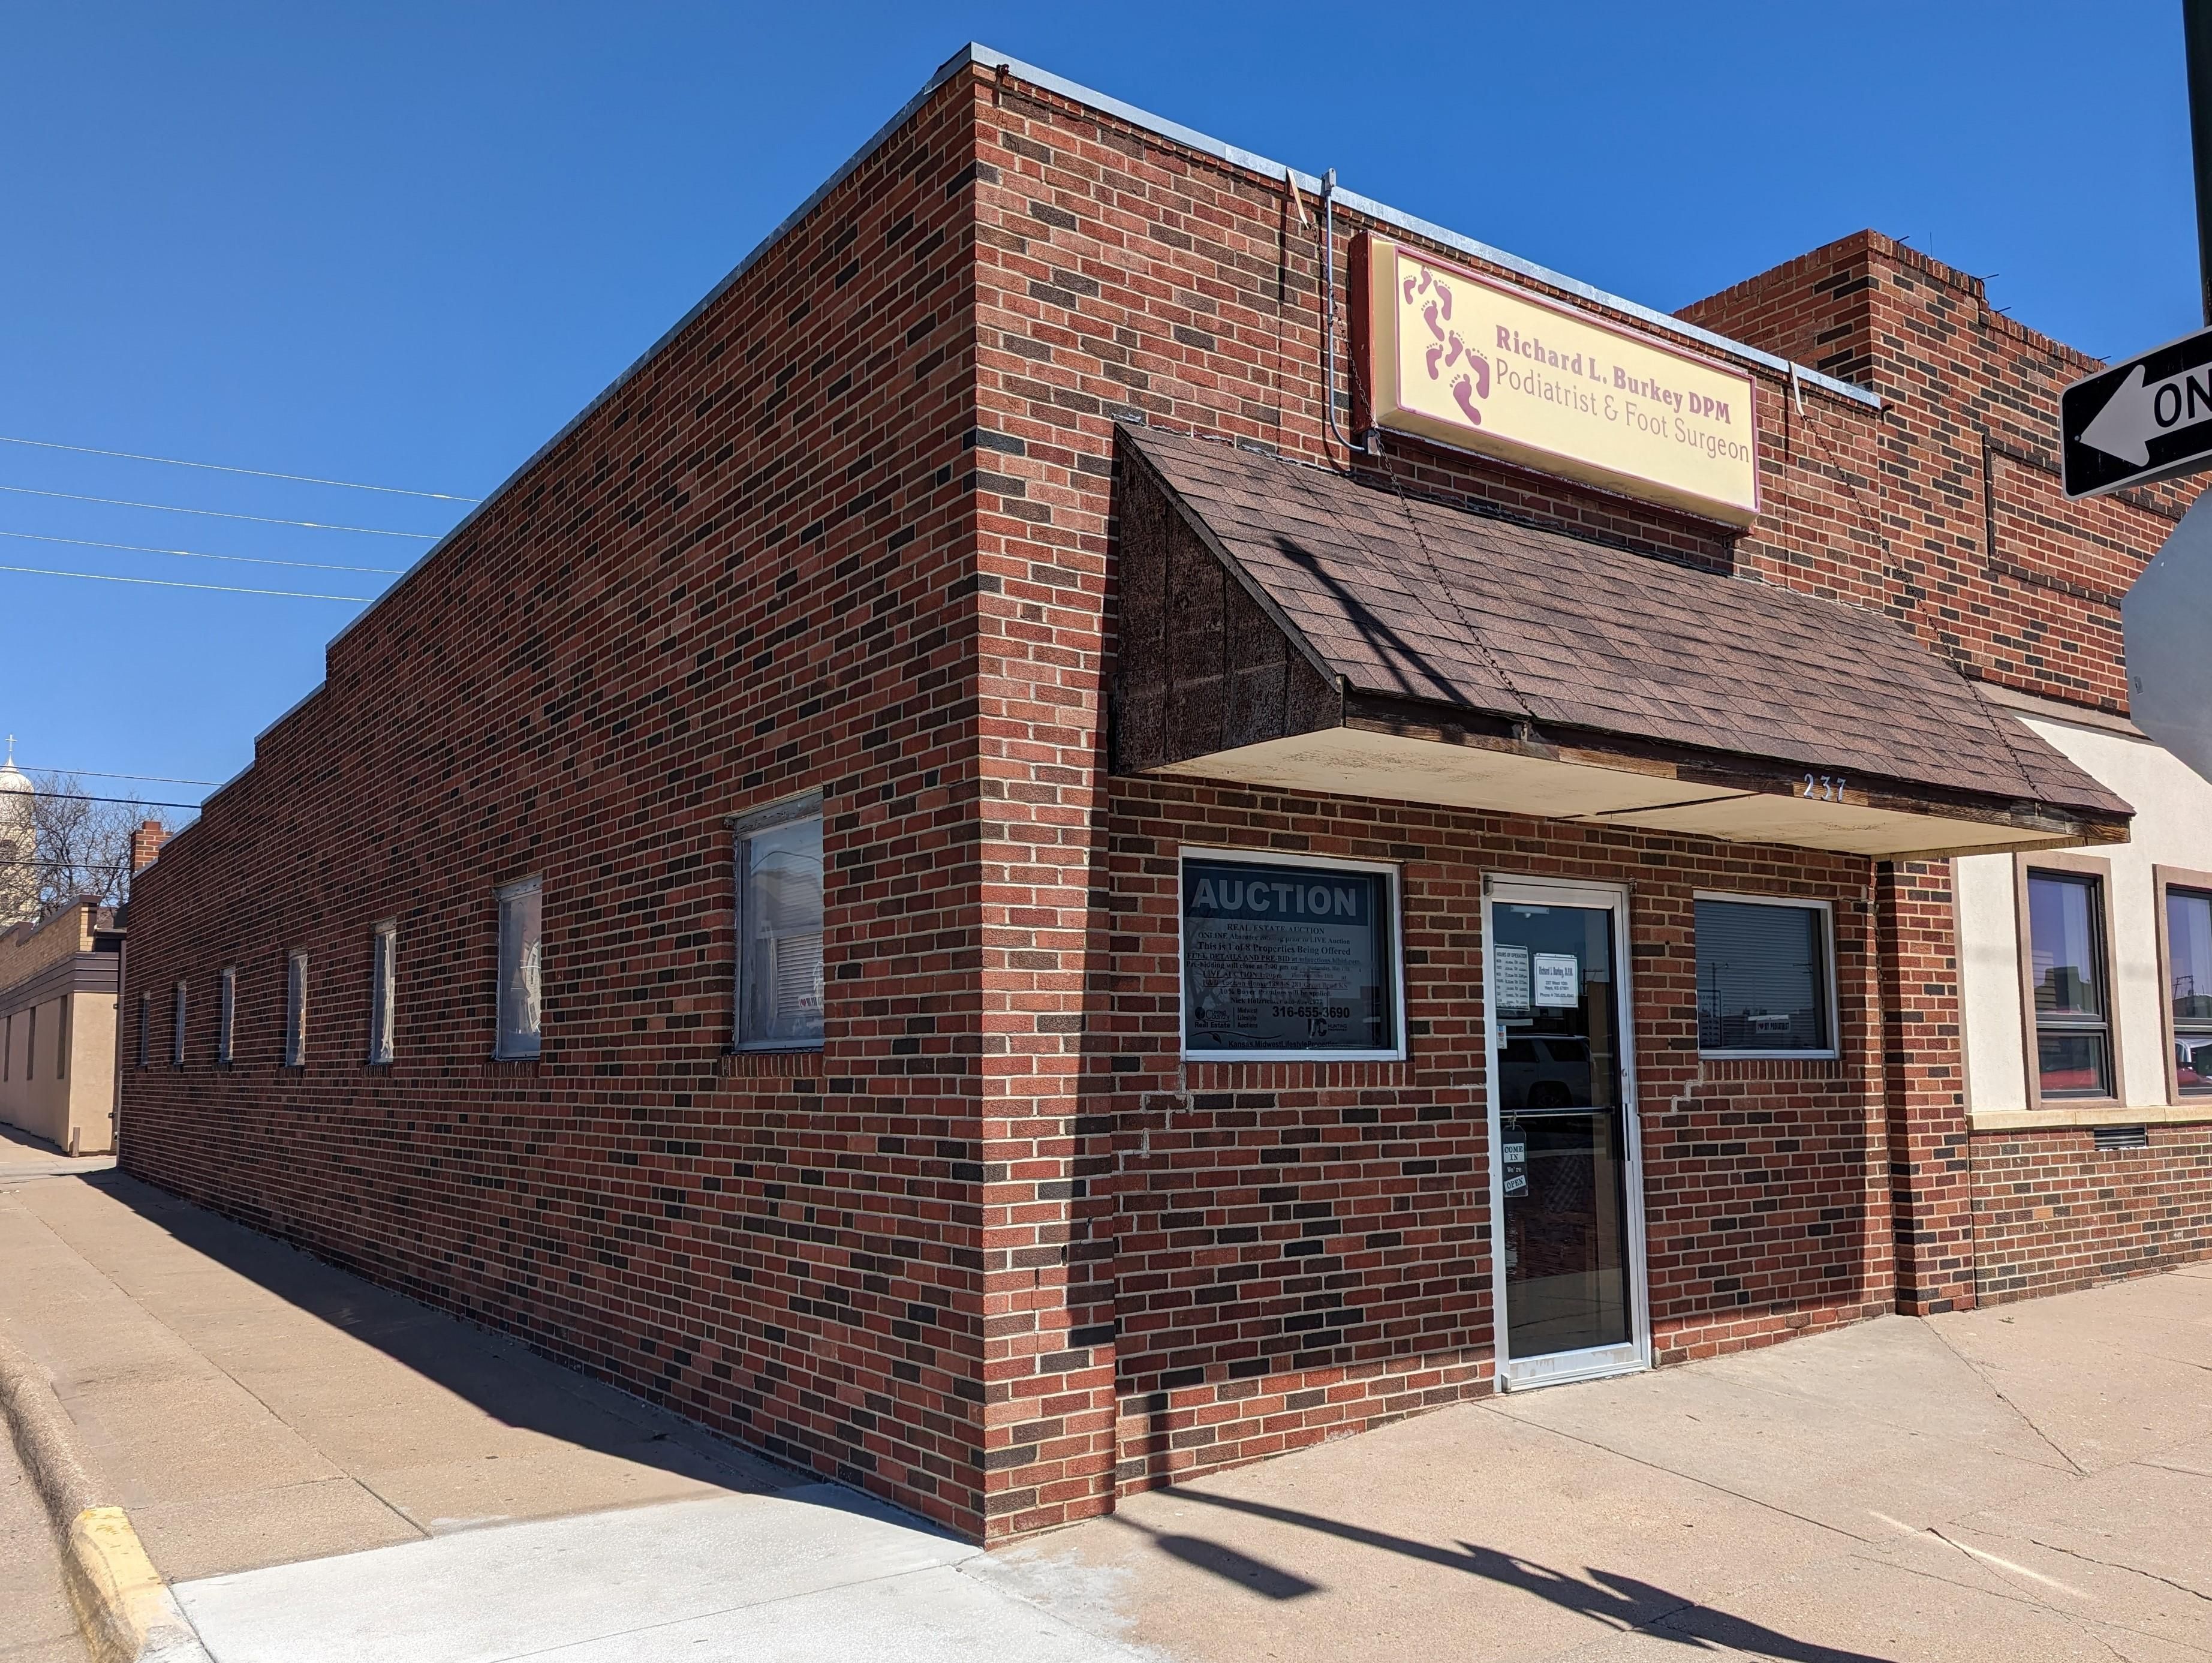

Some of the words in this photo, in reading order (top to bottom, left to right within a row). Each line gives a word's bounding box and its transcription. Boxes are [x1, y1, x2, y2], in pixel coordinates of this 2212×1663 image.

[1495, 324, 1583, 376] Richard
[1589, 359, 1608, 385] L.
[1613, 365, 1684, 411] Burkey
[1689, 386, 1732, 425] DPM
[1496, 357, 1597, 416] Podiatrist
[1604, 395, 1619, 422] &
[1626, 401, 1669, 439] Foot
[1674, 419, 1750, 463] Surgeon
[1804, 773, 1846, 802] 237
[1191, 878, 1357, 916] AUCTION
[1289, 926, 1325, 935] AUCTION
[1328, 937, 1350, 945] Auction
[1198, 942, 1217, 951] This
[1218, 942, 1226, 951] is
[1235, 943, 1244, 951] of
[1253, 944, 1295, 954] Properties
[1297, 945, 1319, 956] Being
[1321, 946, 1351, 955] Offered
[1186, 961, 1224, 970] Pre-bidding
[1279, 964, 1289, 973] pm
[1272, 1006, 1350, 1018] 316-655-3690
[1507, 1177, 1524, 1190] OPEN
